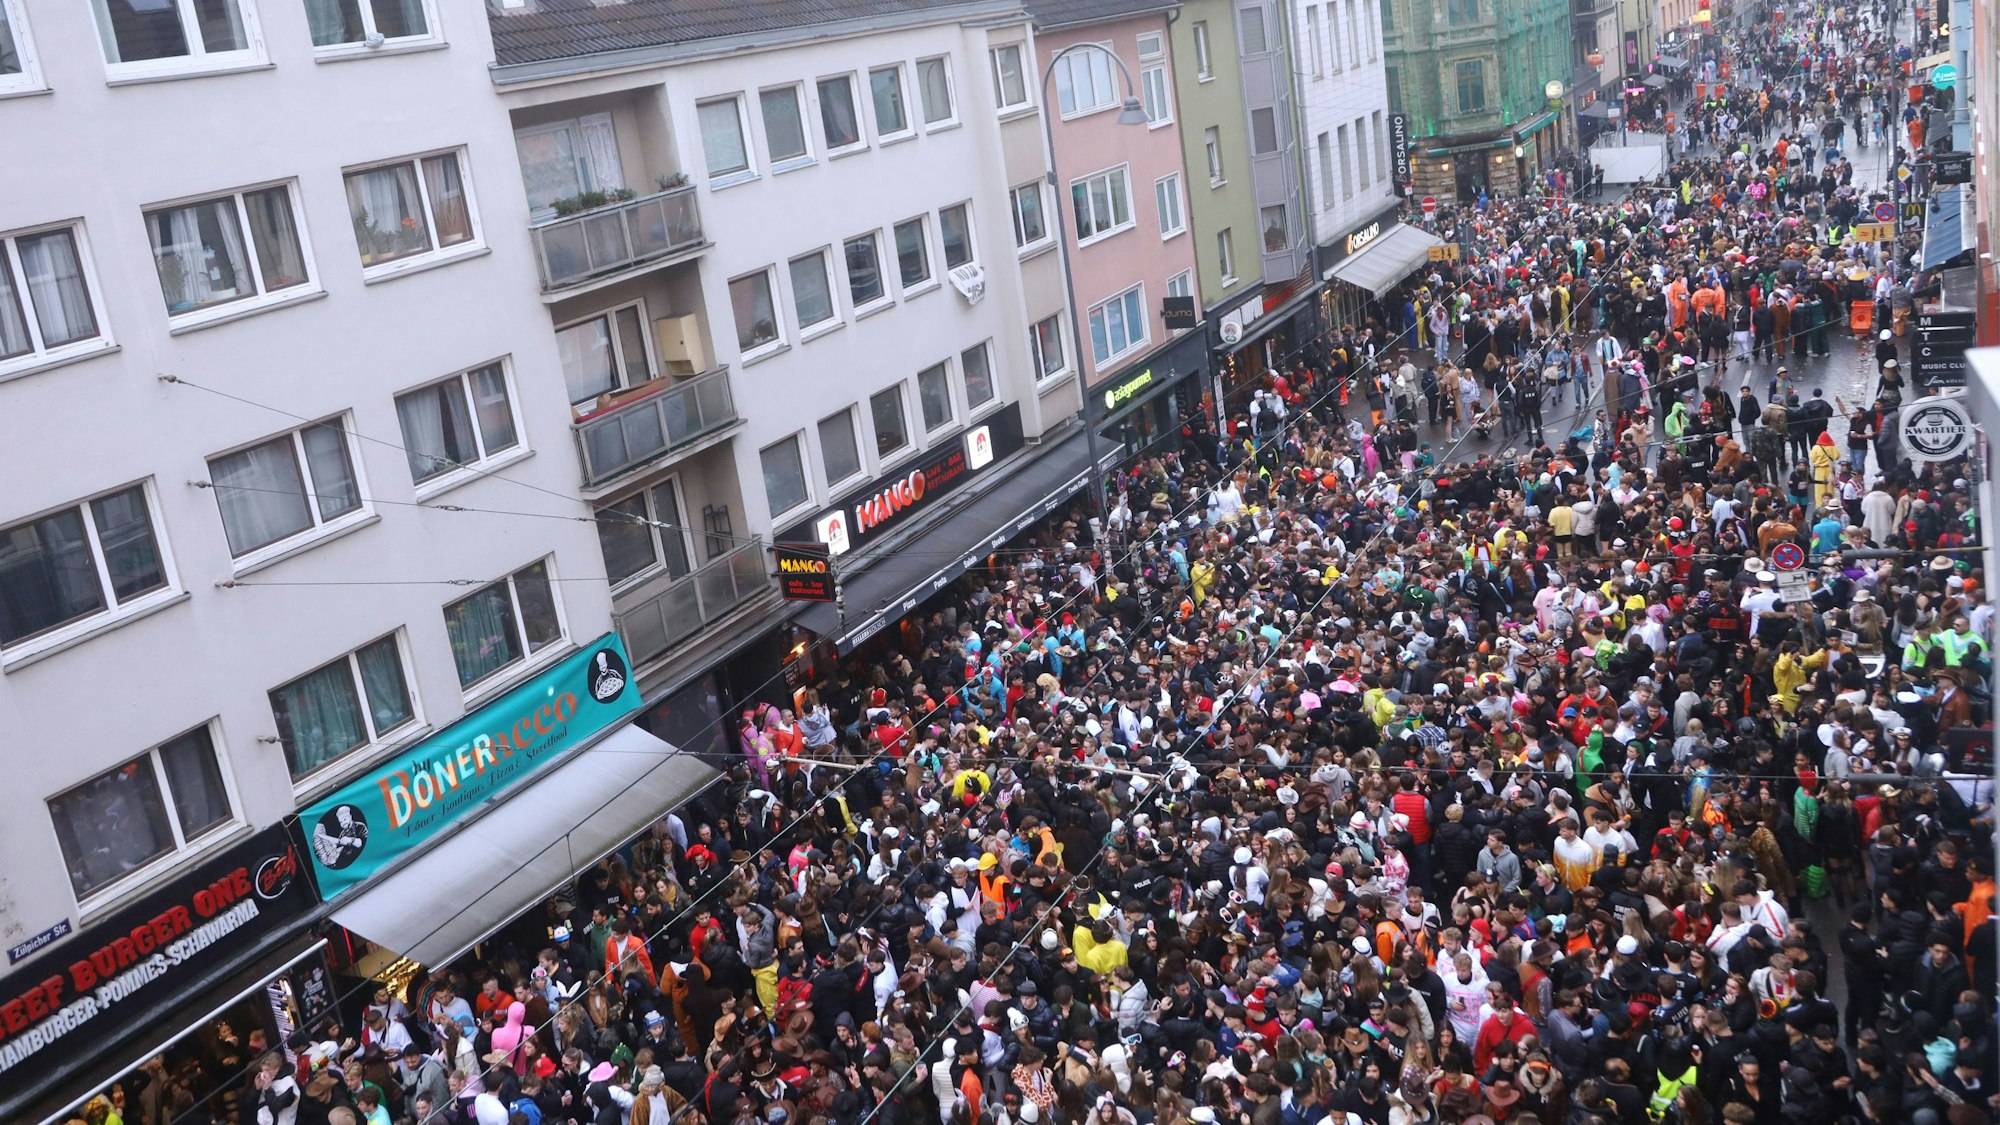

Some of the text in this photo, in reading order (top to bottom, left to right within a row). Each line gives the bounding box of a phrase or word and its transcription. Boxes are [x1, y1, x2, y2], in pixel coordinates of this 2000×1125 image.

[1905, 426, 1966, 435] KWARTIER
[856, 469, 926, 534] MANGO
[780, 558, 826, 573] MANGO
[933, 576, 947, 590] Pasta
[1134, 879, 1151, 890] POLICE
[13, 923, 68, 960] Zülpicher Str.
[0, 866, 252, 1040] EEF BURGER ONE
